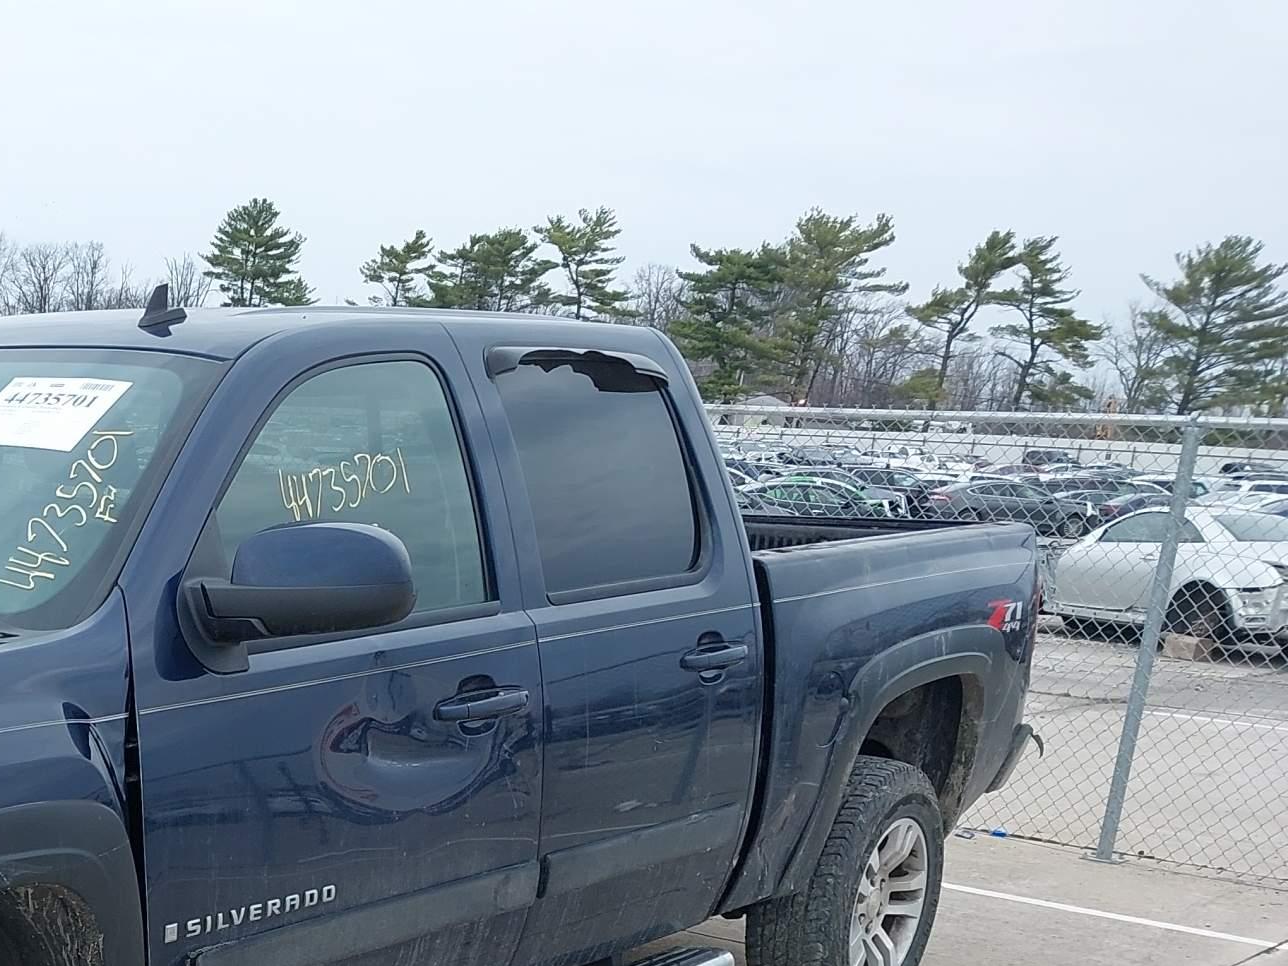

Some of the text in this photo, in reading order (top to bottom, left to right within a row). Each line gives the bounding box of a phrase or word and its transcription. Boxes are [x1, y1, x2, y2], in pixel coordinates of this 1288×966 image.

[4, 391, 99, 408] 44735701
[278, 447, 410, 522] 44735701
[185, 884, 337, 938] SILVERADO
